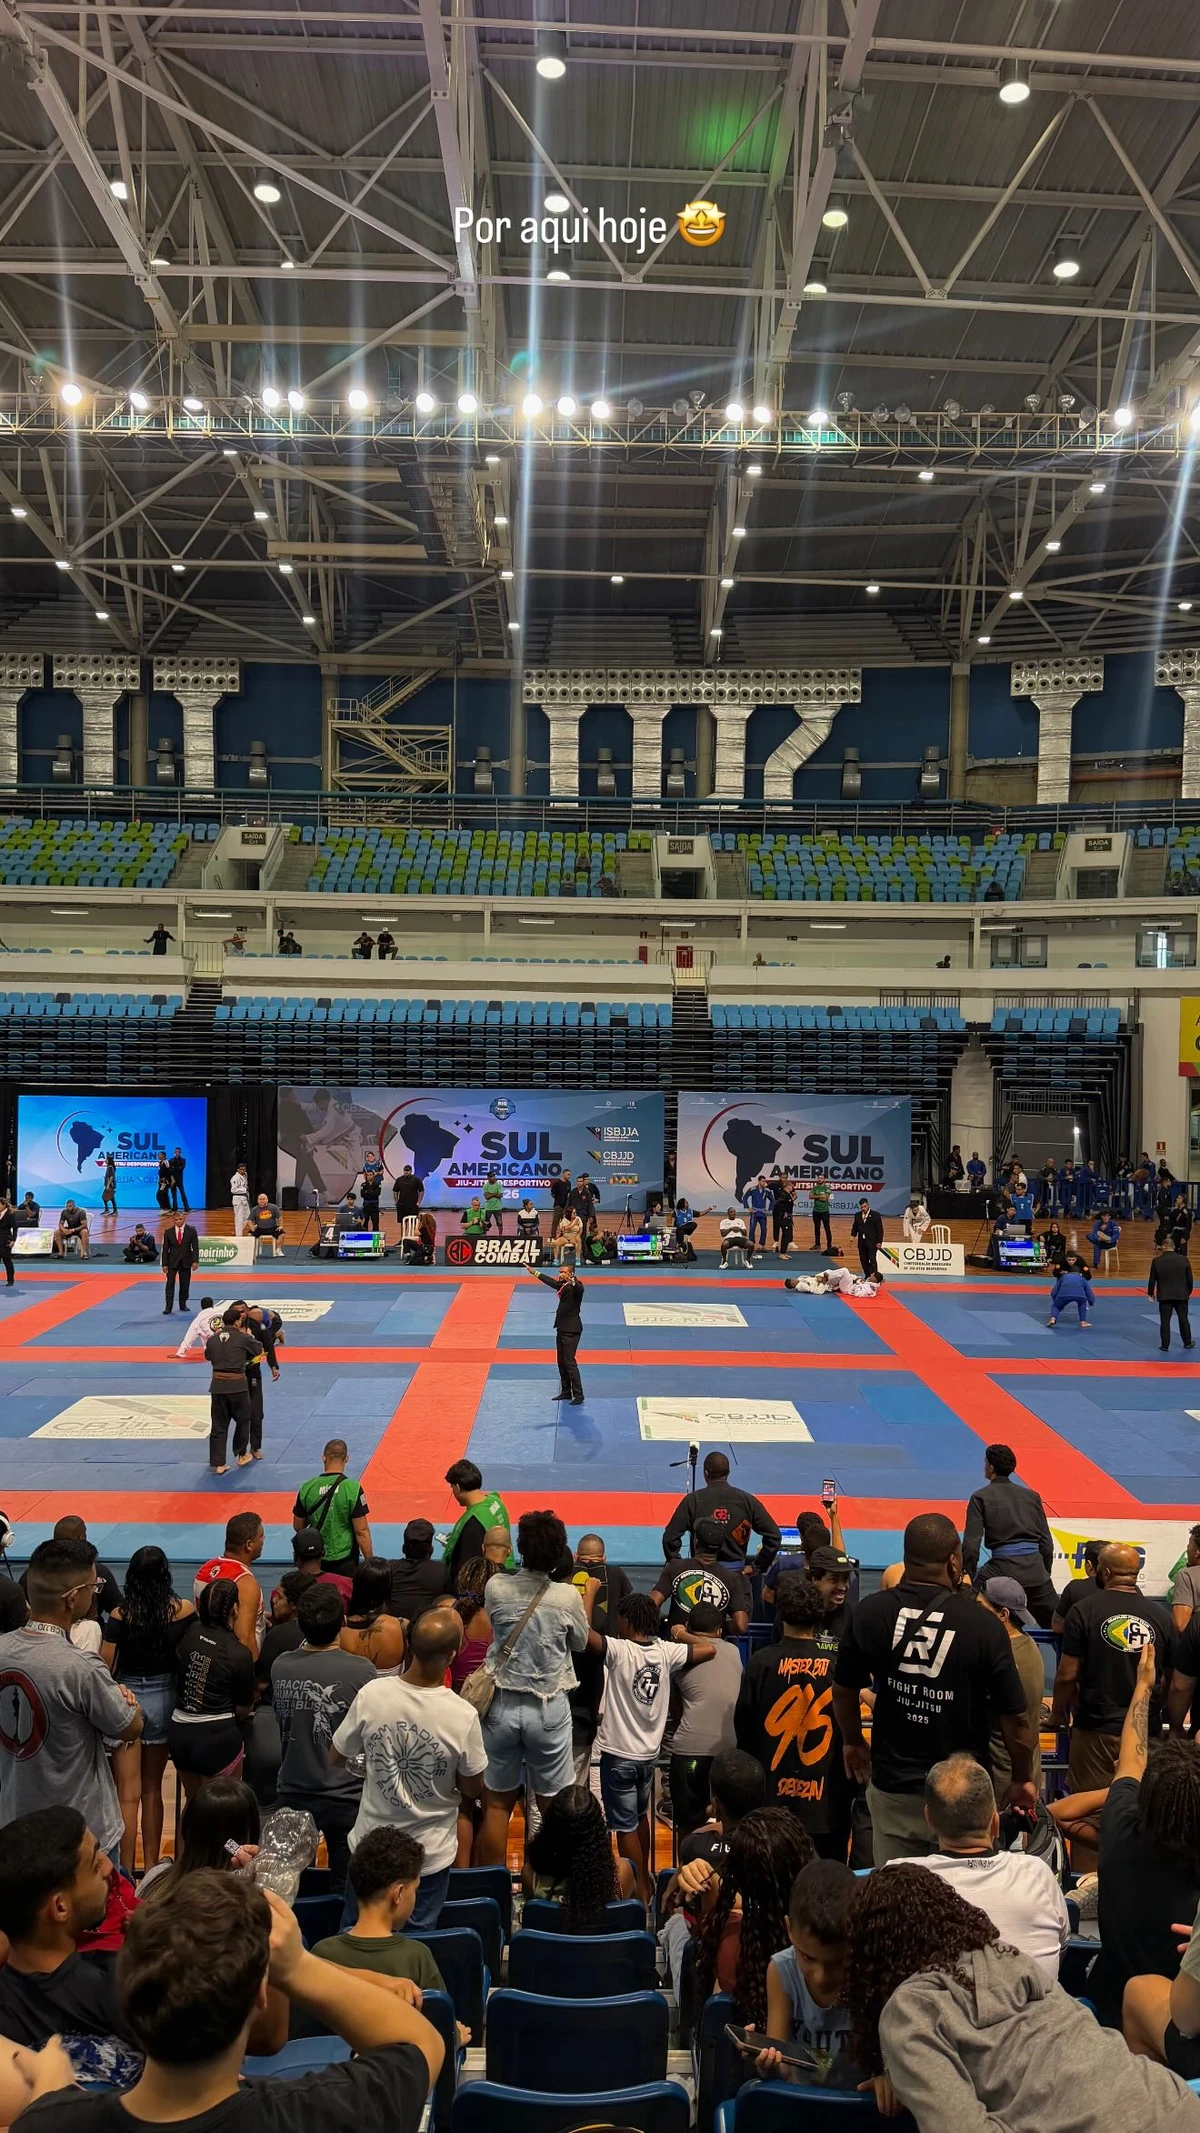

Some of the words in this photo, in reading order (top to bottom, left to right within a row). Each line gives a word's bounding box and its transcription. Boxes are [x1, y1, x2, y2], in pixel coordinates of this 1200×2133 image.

[603, 1126, 639, 1137] ISBJJA
[117, 1132, 166, 1151] SUL
[480, 1131, 563, 1161] SUL
[98, 1151, 166, 1160] AMERICAN
[603, 1151, 635, 1160] CBJJD
[802, 1134, 884, 1165] SUL
[447, 1162, 562, 1176] AMERICANO
[769, 1165, 884, 1180] AMERICANO
[455, 1179, 488, 1187] JIU-JIT
[826, 1183, 873, 1191] ESPORTIVO
[324, 1228, 335, 1240] 4
[662, 1234, 671, 1246] 3
[476, 1239, 541, 1253] BRAZIL
[474, 1252, 538, 1264] COMBAT
[903, 1248, 953, 1261] CBJJD
[704, 1413, 793, 1421] CBJJD
[275, 1679, 310, 1691] GRACIE
[887, 1677, 918, 1695] FIGHT
[922, 1686, 955, 1701] ROOM
[896, 1696, 942, 1714] JIU-JITSU
[906, 1713, 929, 1725] 2025
[764, 1682, 833, 1772] 96
